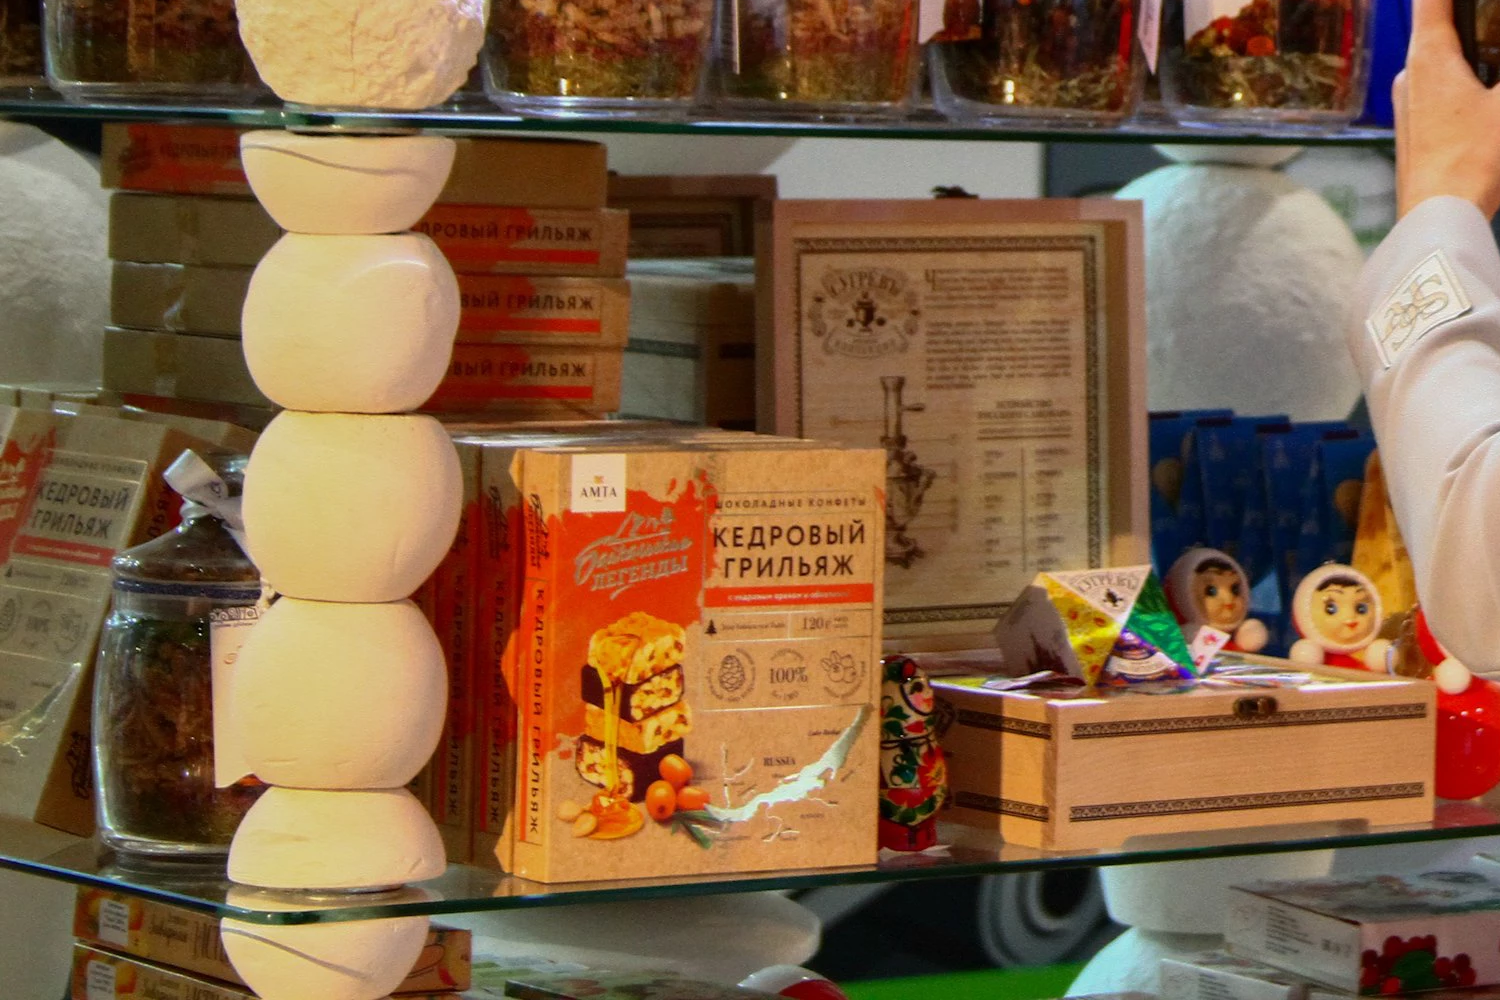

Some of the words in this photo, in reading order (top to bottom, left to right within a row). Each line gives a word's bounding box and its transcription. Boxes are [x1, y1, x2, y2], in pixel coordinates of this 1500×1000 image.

[420, 221, 498, 239] ДРОВЫЙ
[506, 224, 593, 241] ГРИЛЬЯЖ
[506, 294, 594, 311] ГРИЛЬЯЖ
[501, 360, 586, 377] ГРИЛЬЯЖ
[37, 479, 129, 512] КЕДРОВЫЙ
[714, 499, 802, 510] ШОКОЛАДНЫЕ
[808, 497, 867, 508] КОНФЕТЫ
[31, 508, 113, 539] ГРИЛЬЯЖ
[713, 519, 865, 550] КЕДРОВЫЙ
[590, 555, 688, 592] ЛЕГЕНДЫ
[724, 555, 854, 579] ГРИЛЬЯЖ
[533, 588, 545, 716] КЕДРОВЫЙ
[769, 667, 808, 684] 100%
[489, 716, 502, 824] ГРИЛЬЯЖ
[529, 725, 543, 835] ГРИЛЬЯЖ
